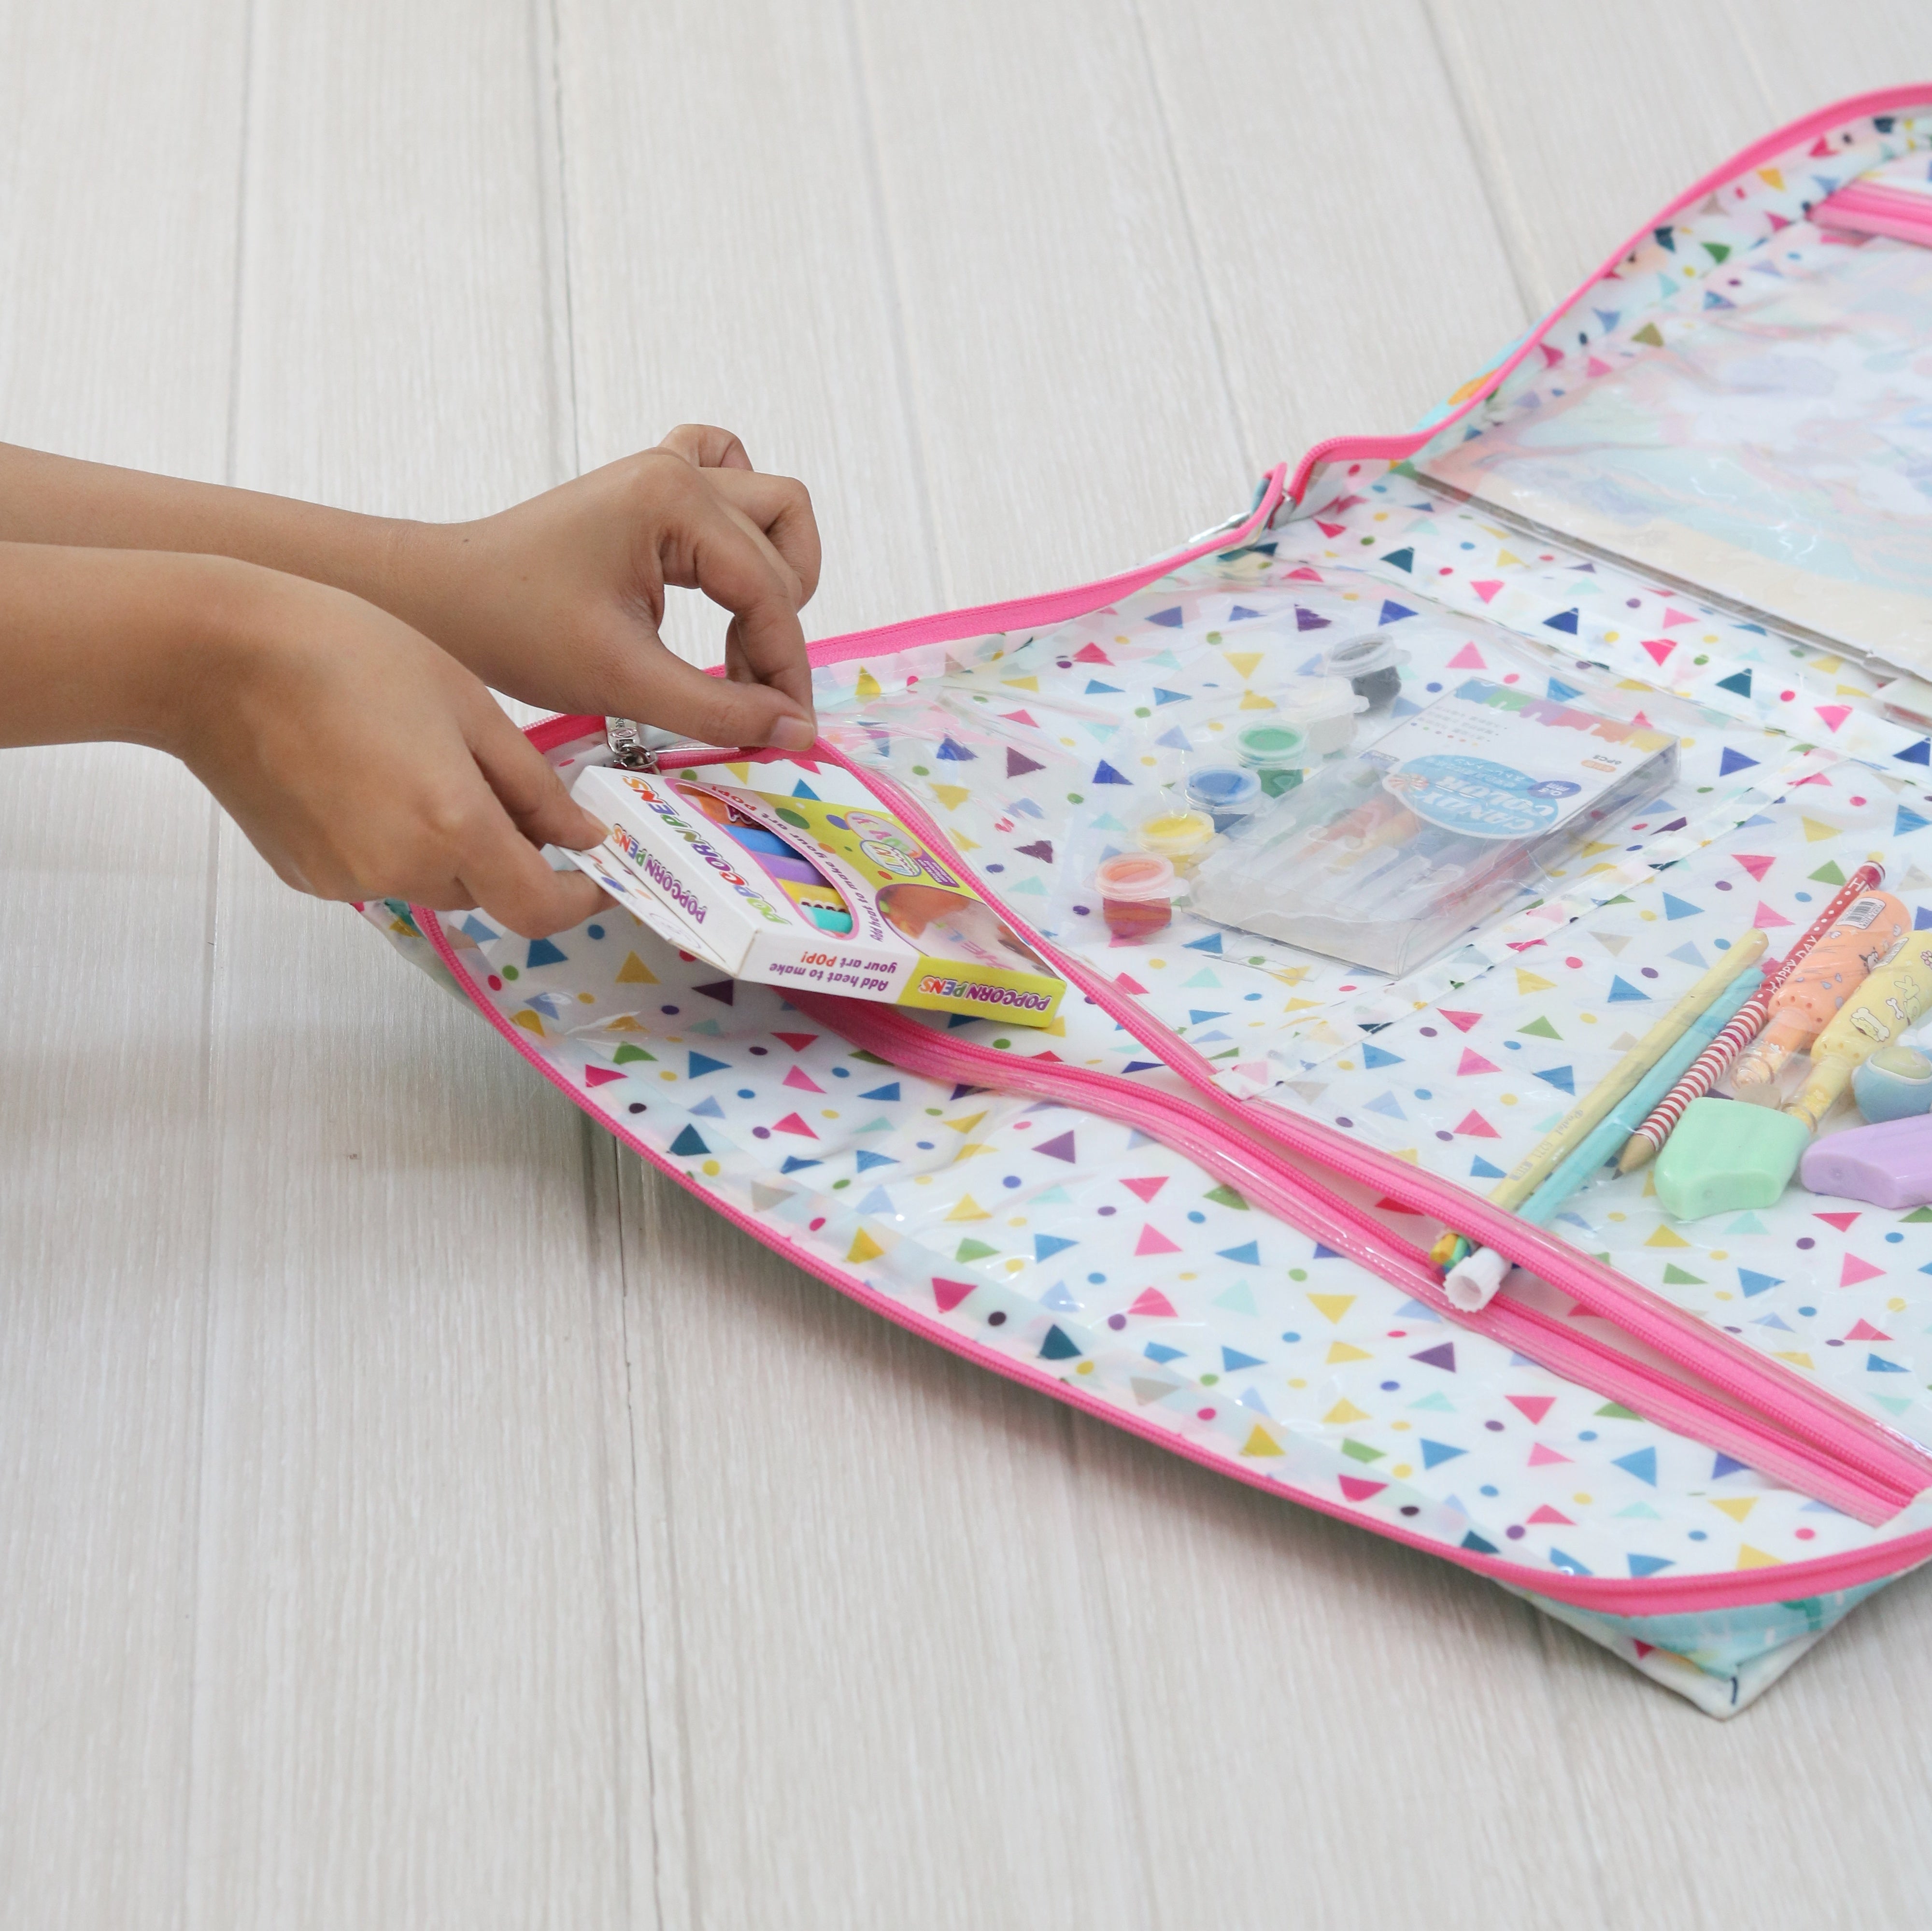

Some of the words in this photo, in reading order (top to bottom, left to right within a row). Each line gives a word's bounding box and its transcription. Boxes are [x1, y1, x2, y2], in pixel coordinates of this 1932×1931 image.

[621, 775, 693, 829] PENS
[711, 785, 757, 811] POP!
[1435, 776, 1554, 816] COLOR
[761, 812, 788, 830] art
[1413, 791, 1534, 830] CANDY
[611, 824, 647, 867] PENS
[789, 832, 828, 859] your
[673, 827, 792, 925] POPCORN
[825, 861, 858, 890] make
[645, 854, 708, 924] POPCORN
[855, 892, 868, 903] to
[862, 905, 881, 928] heat
[870, 926, 883, 942] Add
[769, 963, 807, 975] make
[800, 951, 837, 967] POP!
[839, 958, 862, 968] art
[864, 962, 897, 974] your
[1766, 959, 1797, 994] HAPPY
[1795, 935, 1817, 959] DAY
[809, 969, 824, 981] to
[827, 972, 859, 987] heat
[860, 978, 889, 991] Add
[919, 976, 969, 998] PENS
[965, 982, 1052, 1011] POPCORN
